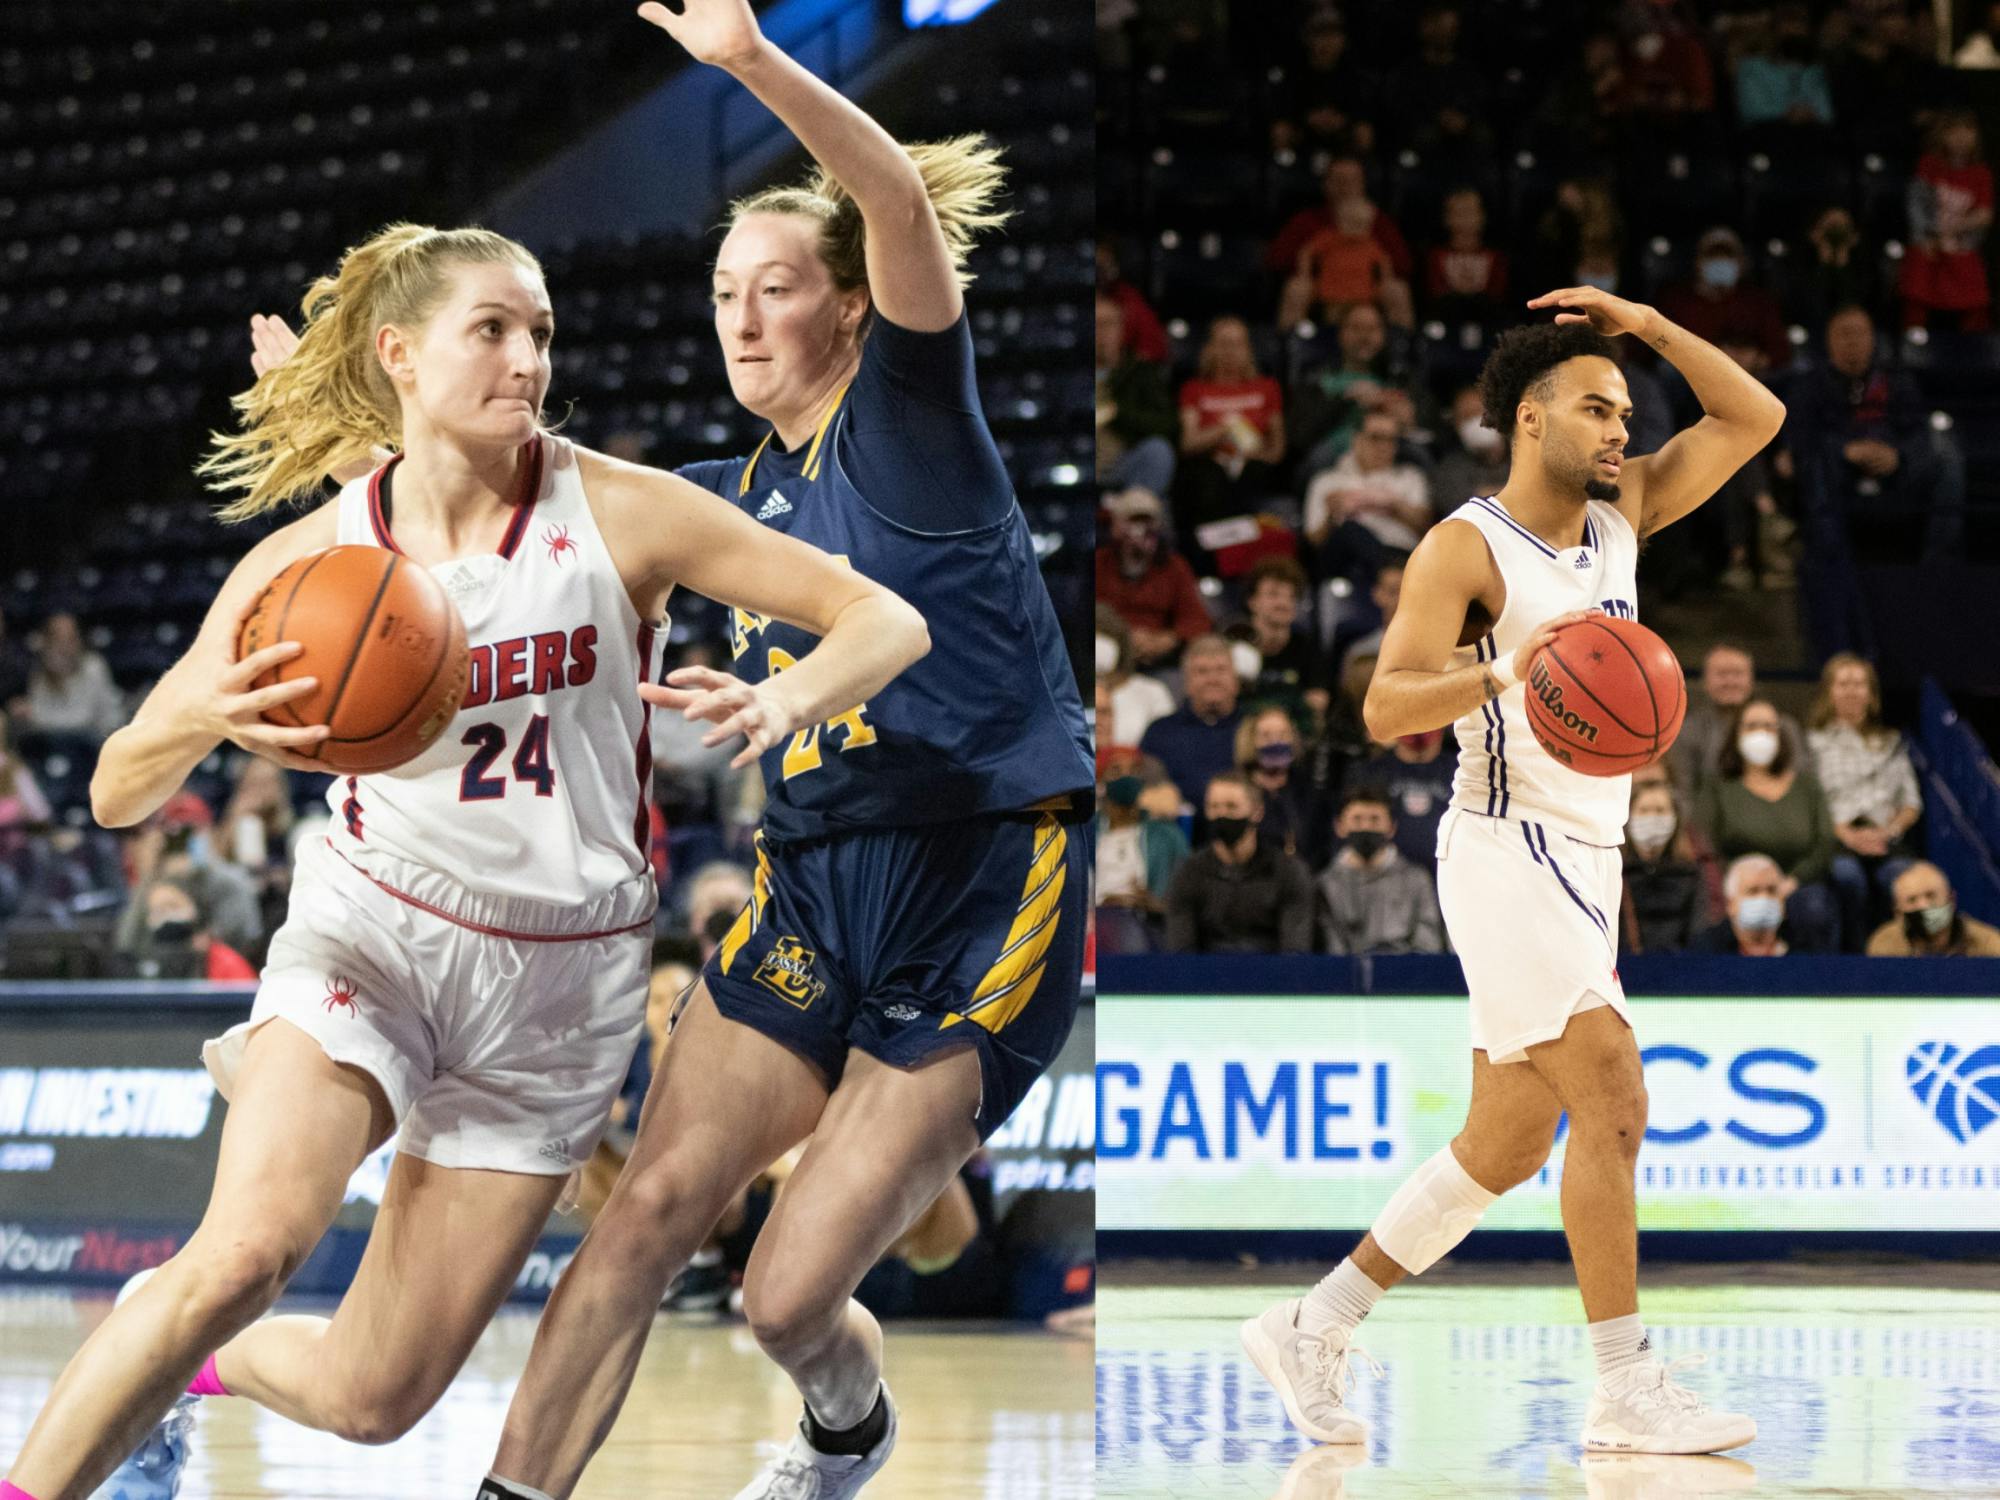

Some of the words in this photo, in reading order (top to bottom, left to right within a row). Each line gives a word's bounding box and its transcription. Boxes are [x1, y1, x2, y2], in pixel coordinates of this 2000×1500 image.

[757, 502, 793, 520] adidas
[459, 624, 598, 711] DERS
[1530, 656, 1599, 744] Wilson
[458, 713, 556, 803] 24
[25, 1068, 216, 1138] INVESTING
[1096, 1061, 1393, 1161] GAME!
[1555, 1043, 1828, 1149] CS
[1644, 1165, 1866, 1188] RDIOVASCULAR
